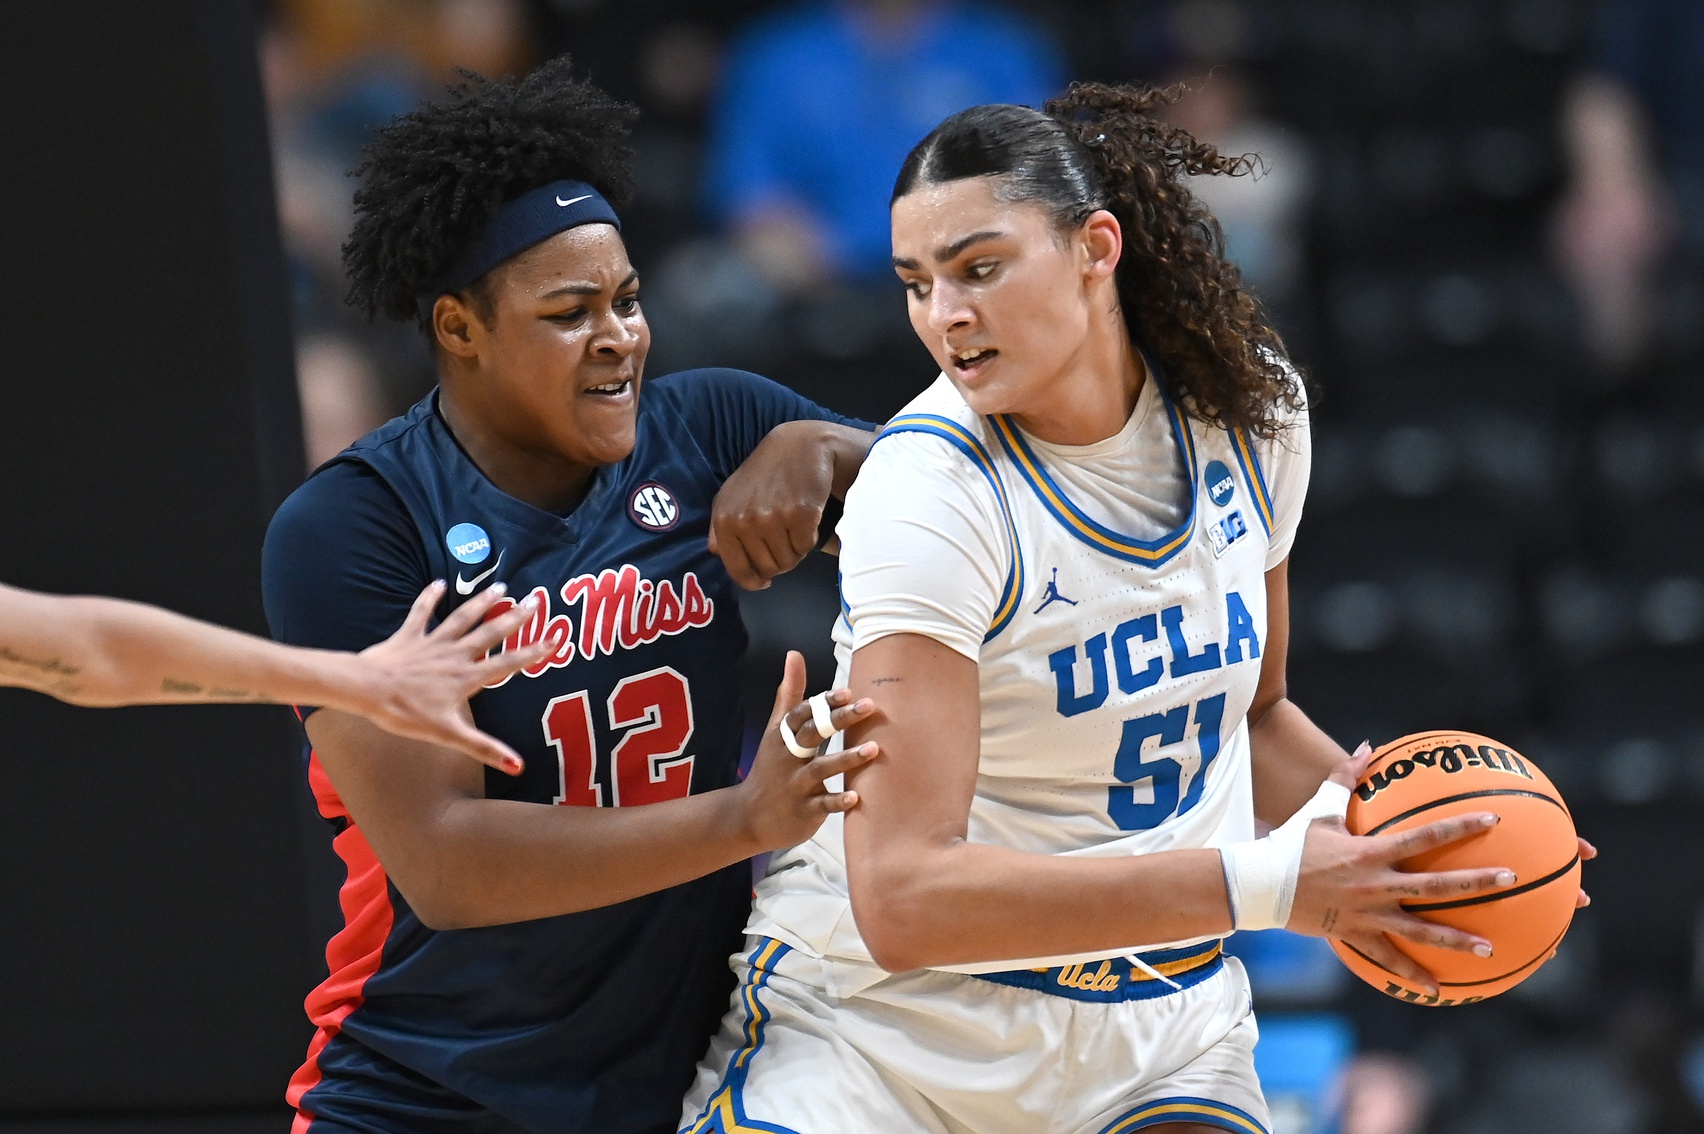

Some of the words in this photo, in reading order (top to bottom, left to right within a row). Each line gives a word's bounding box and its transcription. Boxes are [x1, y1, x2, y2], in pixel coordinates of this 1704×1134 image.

[634, 487, 676, 526] SEC
[1211, 476, 1234, 499] NCAA
[455, 538, 489, 557] NCAA
[560, 563, 714, 661] Miss
[1048, 592, 1261, 718] UCLA
[541, 665, 696, 807] 12
[1107, 692, 1227, 831] 51
[1354, 743, 1535, 802] Wilson
